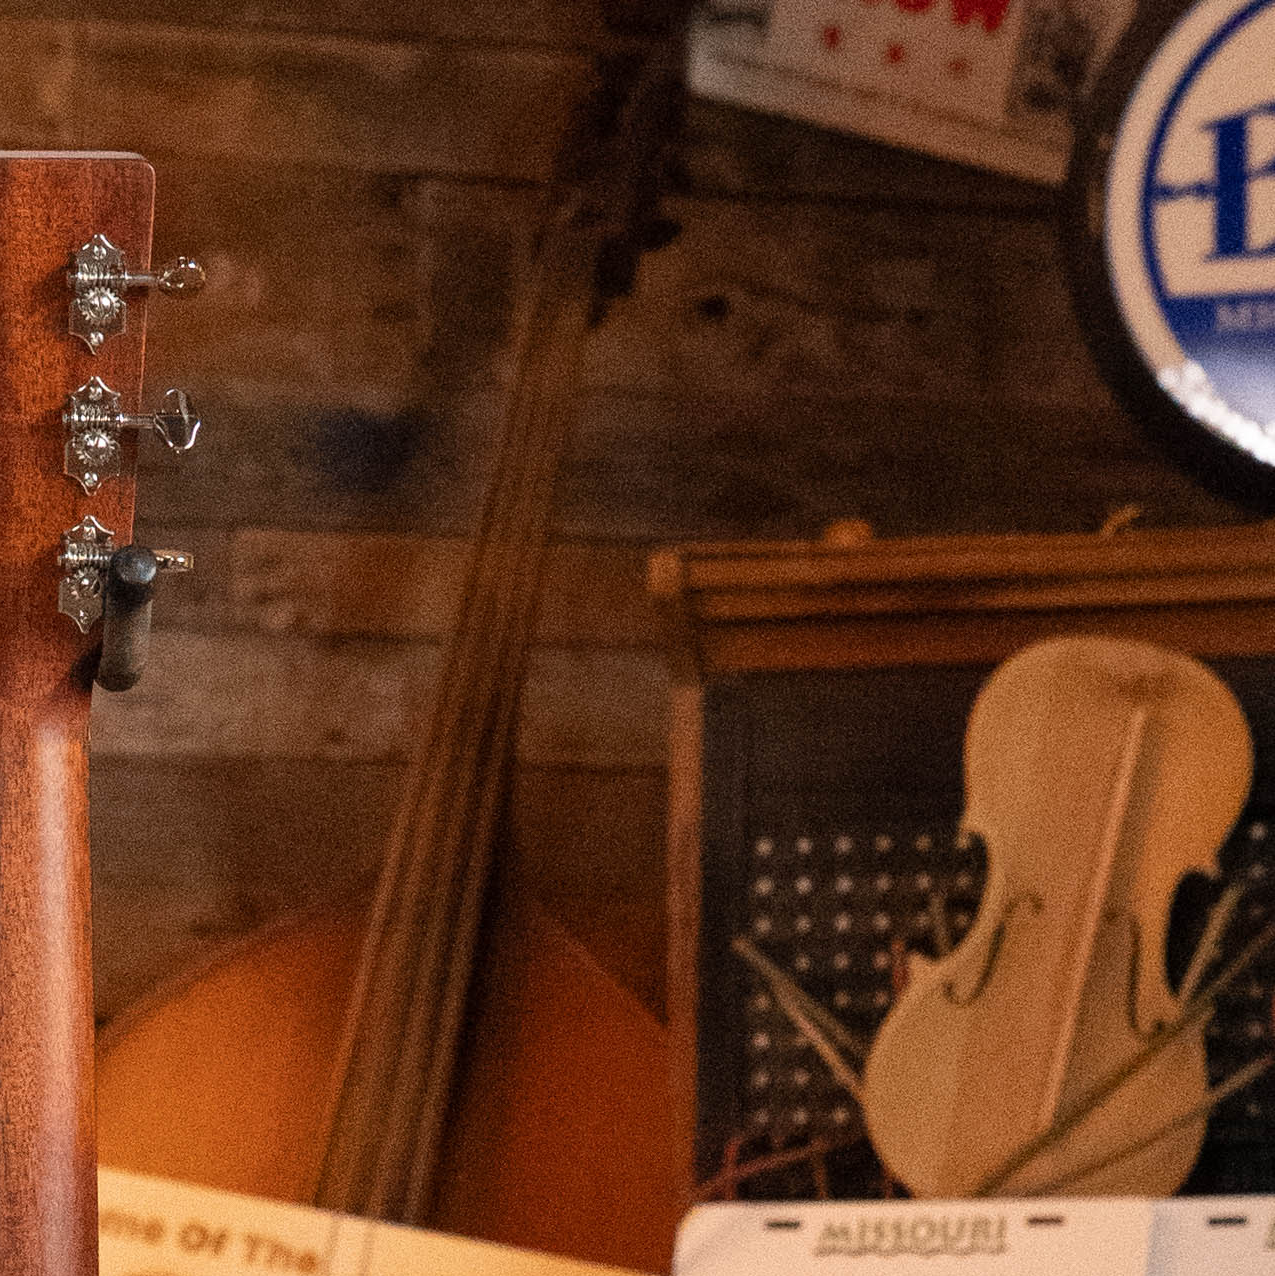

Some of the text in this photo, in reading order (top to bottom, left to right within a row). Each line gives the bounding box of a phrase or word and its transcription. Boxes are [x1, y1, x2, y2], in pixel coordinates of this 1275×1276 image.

[178, 1219, 229, 1256] Of
[243, 1230, 321, 1275] The
[819, 1215, 1008, 1248] MISSOURI
